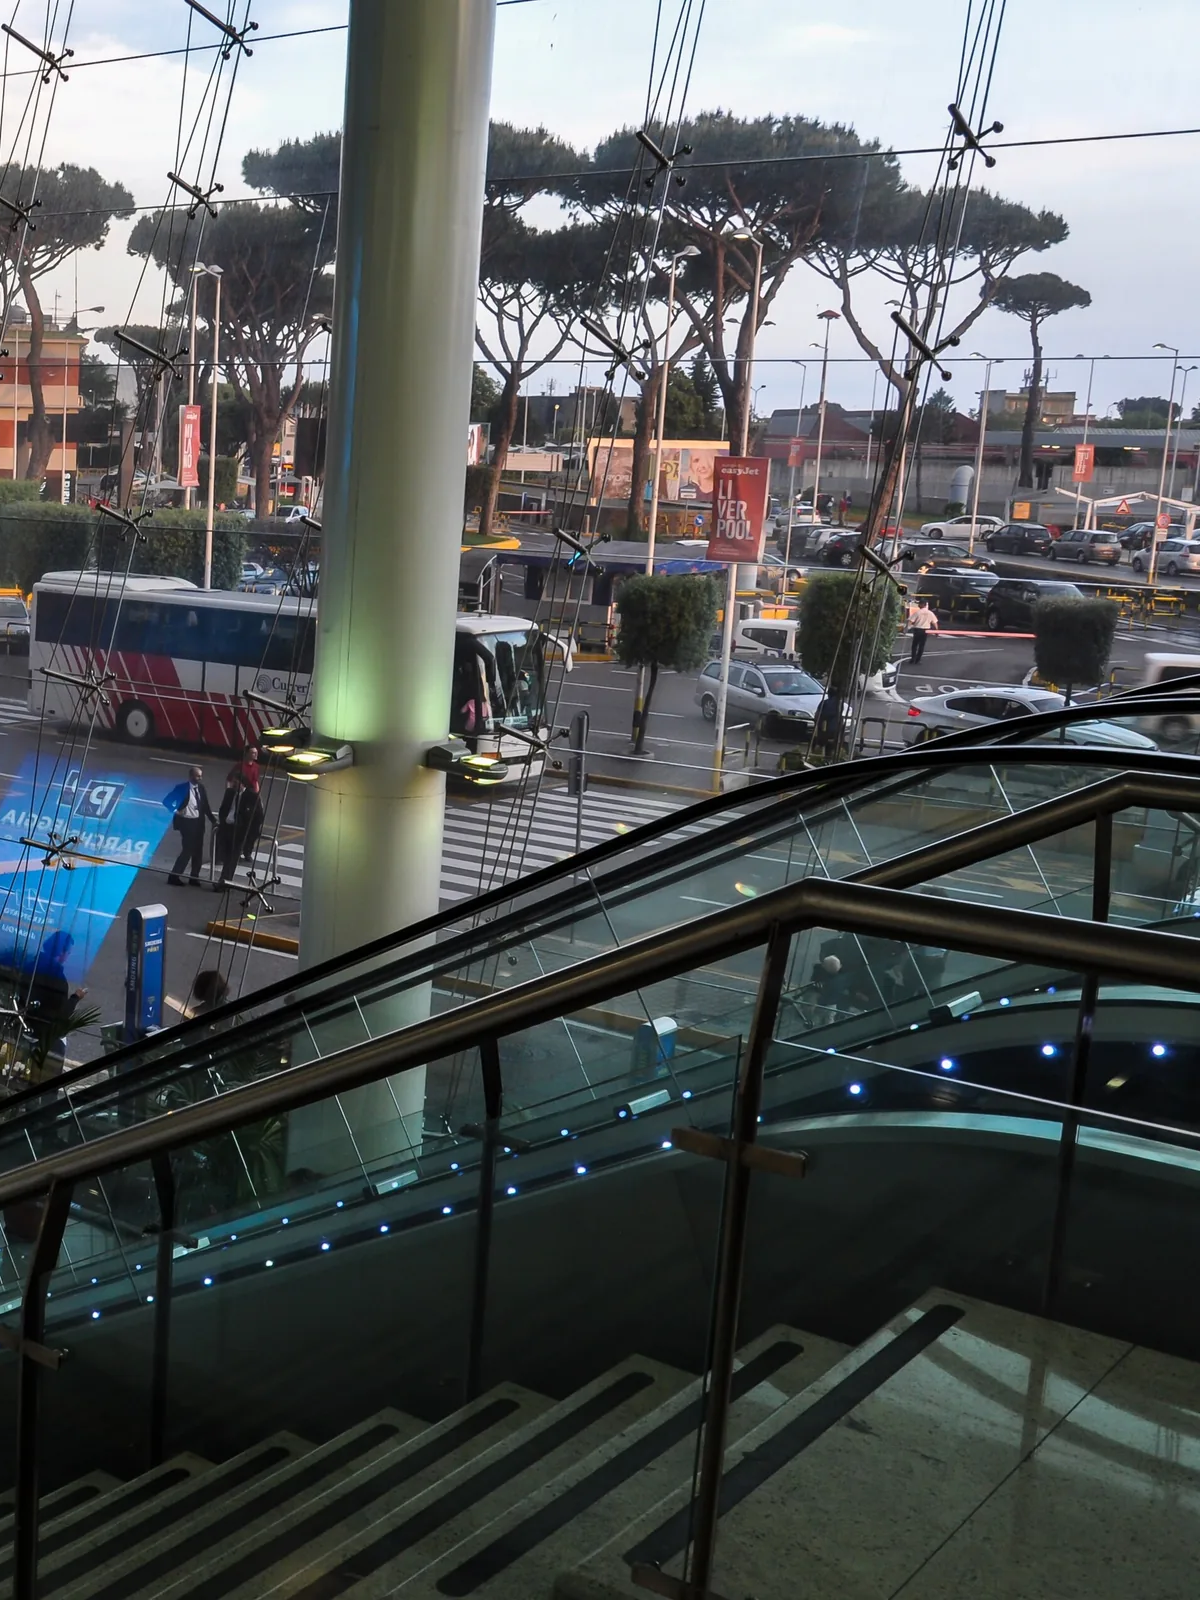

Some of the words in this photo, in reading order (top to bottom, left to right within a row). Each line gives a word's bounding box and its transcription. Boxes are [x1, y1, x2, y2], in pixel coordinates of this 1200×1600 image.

[720, 466, 760, 476] easyJet
[718, 479, 733, 500] LI
[716, 500, 748, 520] VER
[716, 520, 755, 541] POOL
